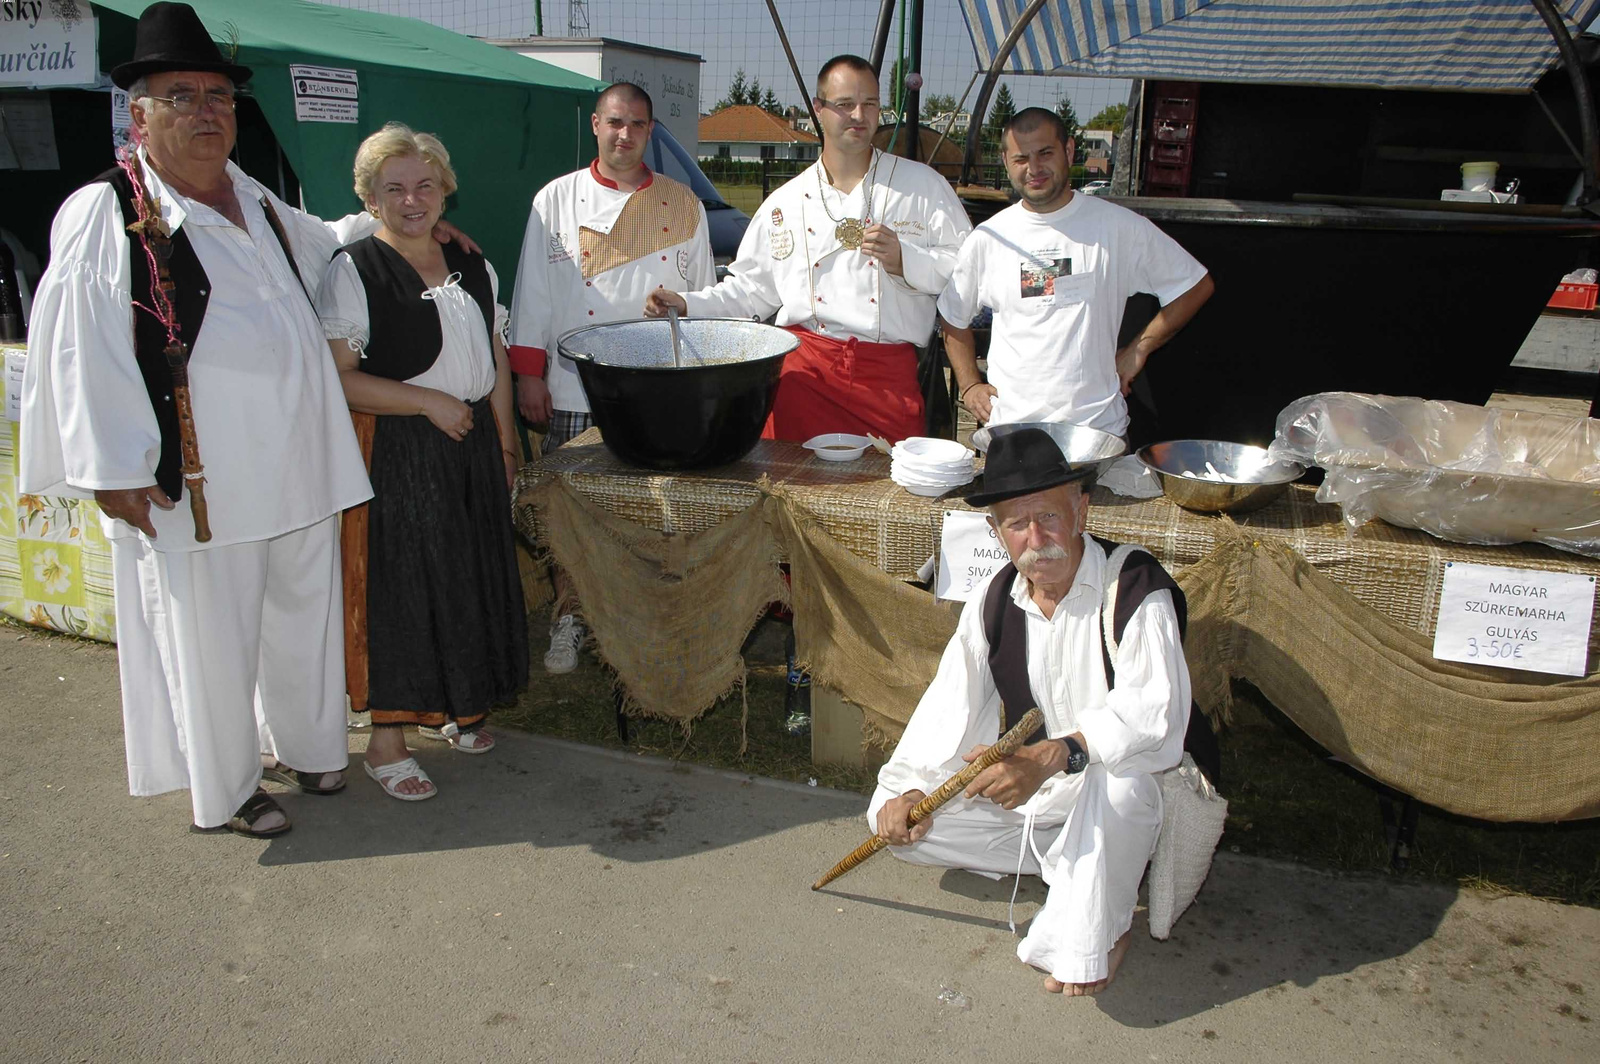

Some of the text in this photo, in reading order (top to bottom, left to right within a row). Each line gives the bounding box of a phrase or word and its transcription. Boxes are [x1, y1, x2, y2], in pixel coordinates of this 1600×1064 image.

[973, 547, 1011, 561] MAĎA
[1489, 582, 1548, 599] MAGYAR
[1464, 601, 1566, 622] SZÜRKEMARHA
[1486, 626, 1538, 642] GULYÁS
